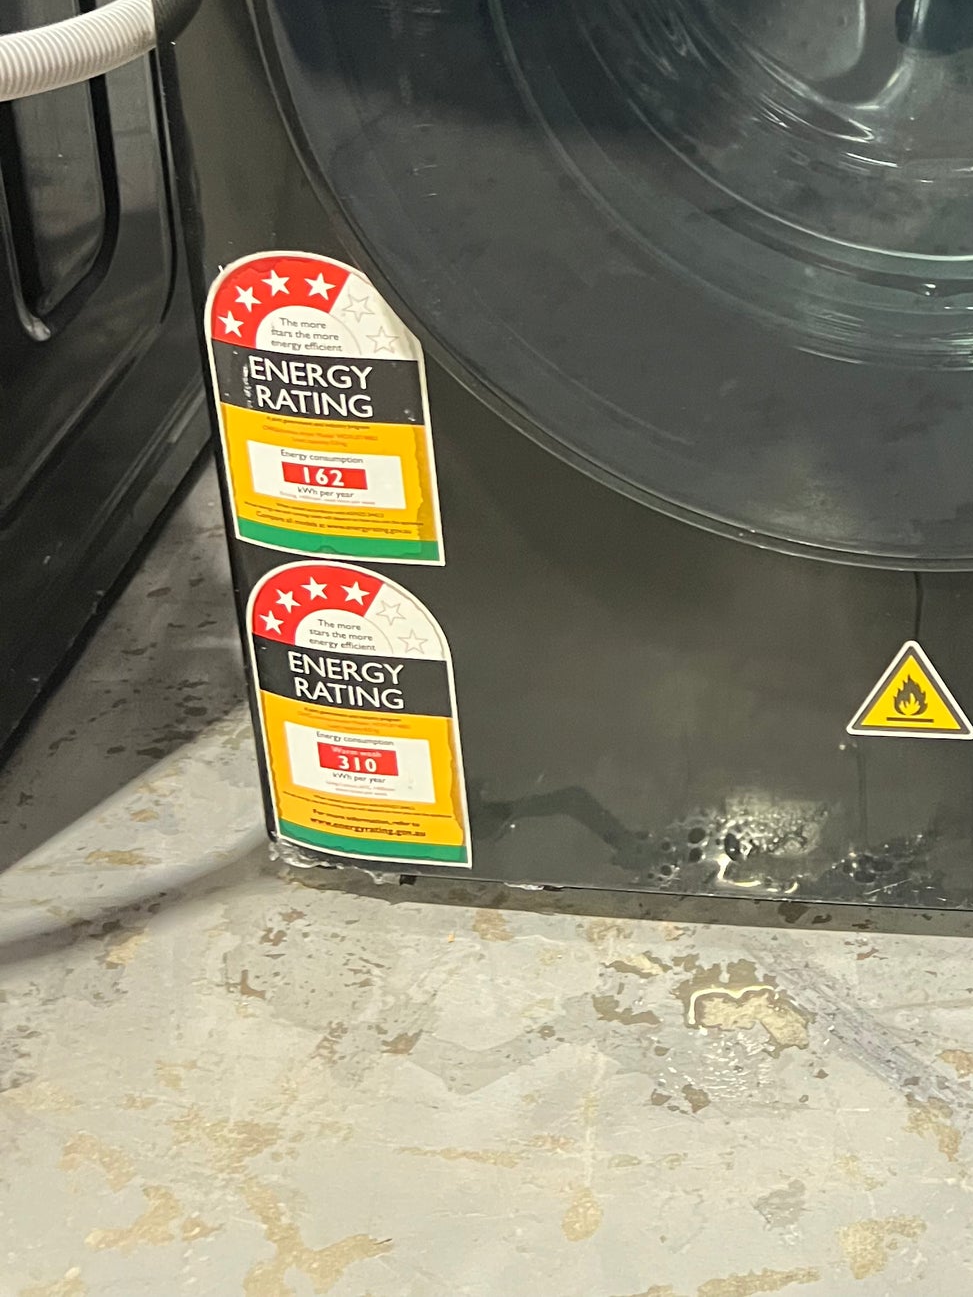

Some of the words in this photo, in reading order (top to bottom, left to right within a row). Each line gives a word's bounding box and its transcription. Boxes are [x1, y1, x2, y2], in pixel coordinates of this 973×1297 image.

[280, 317, 298, 328] The
[301, 321, 327, 329] more
[295, 330, 311, 340] the
[313, 333, 339, 341] more
[271, 340, 302, 351] energy
[304, 342, 343, 352] efficient
[248, 355, 373, 390] ENERGY
[255, 384, 374, 418] RATING
[280, 449, 308, 461] Energy
[310, 454, 364, 465] consumption
[303, 466, 345, 487] 162
[297, 486, 318, 496] kWh
[320, 490, 335, 498] per
[336, 491, 355, 499] year
[318, 618, 335, 628] The
[337, 623, 361, 631] more
[309, 628, 331, 637] stars
[332, 630, 346, 639] the
[349, 633, 373, 641] more
[309, 638, 339, 649] energy
[340, 641, 376, 651] efficient
[287, 650, 404, 685] ENERGY
[294, 676, 405, 710] RATING
[316, 731, 341, 742] Energy
[343, 736, 395, 746] consumption
[338, 755, 378, 773] 310
